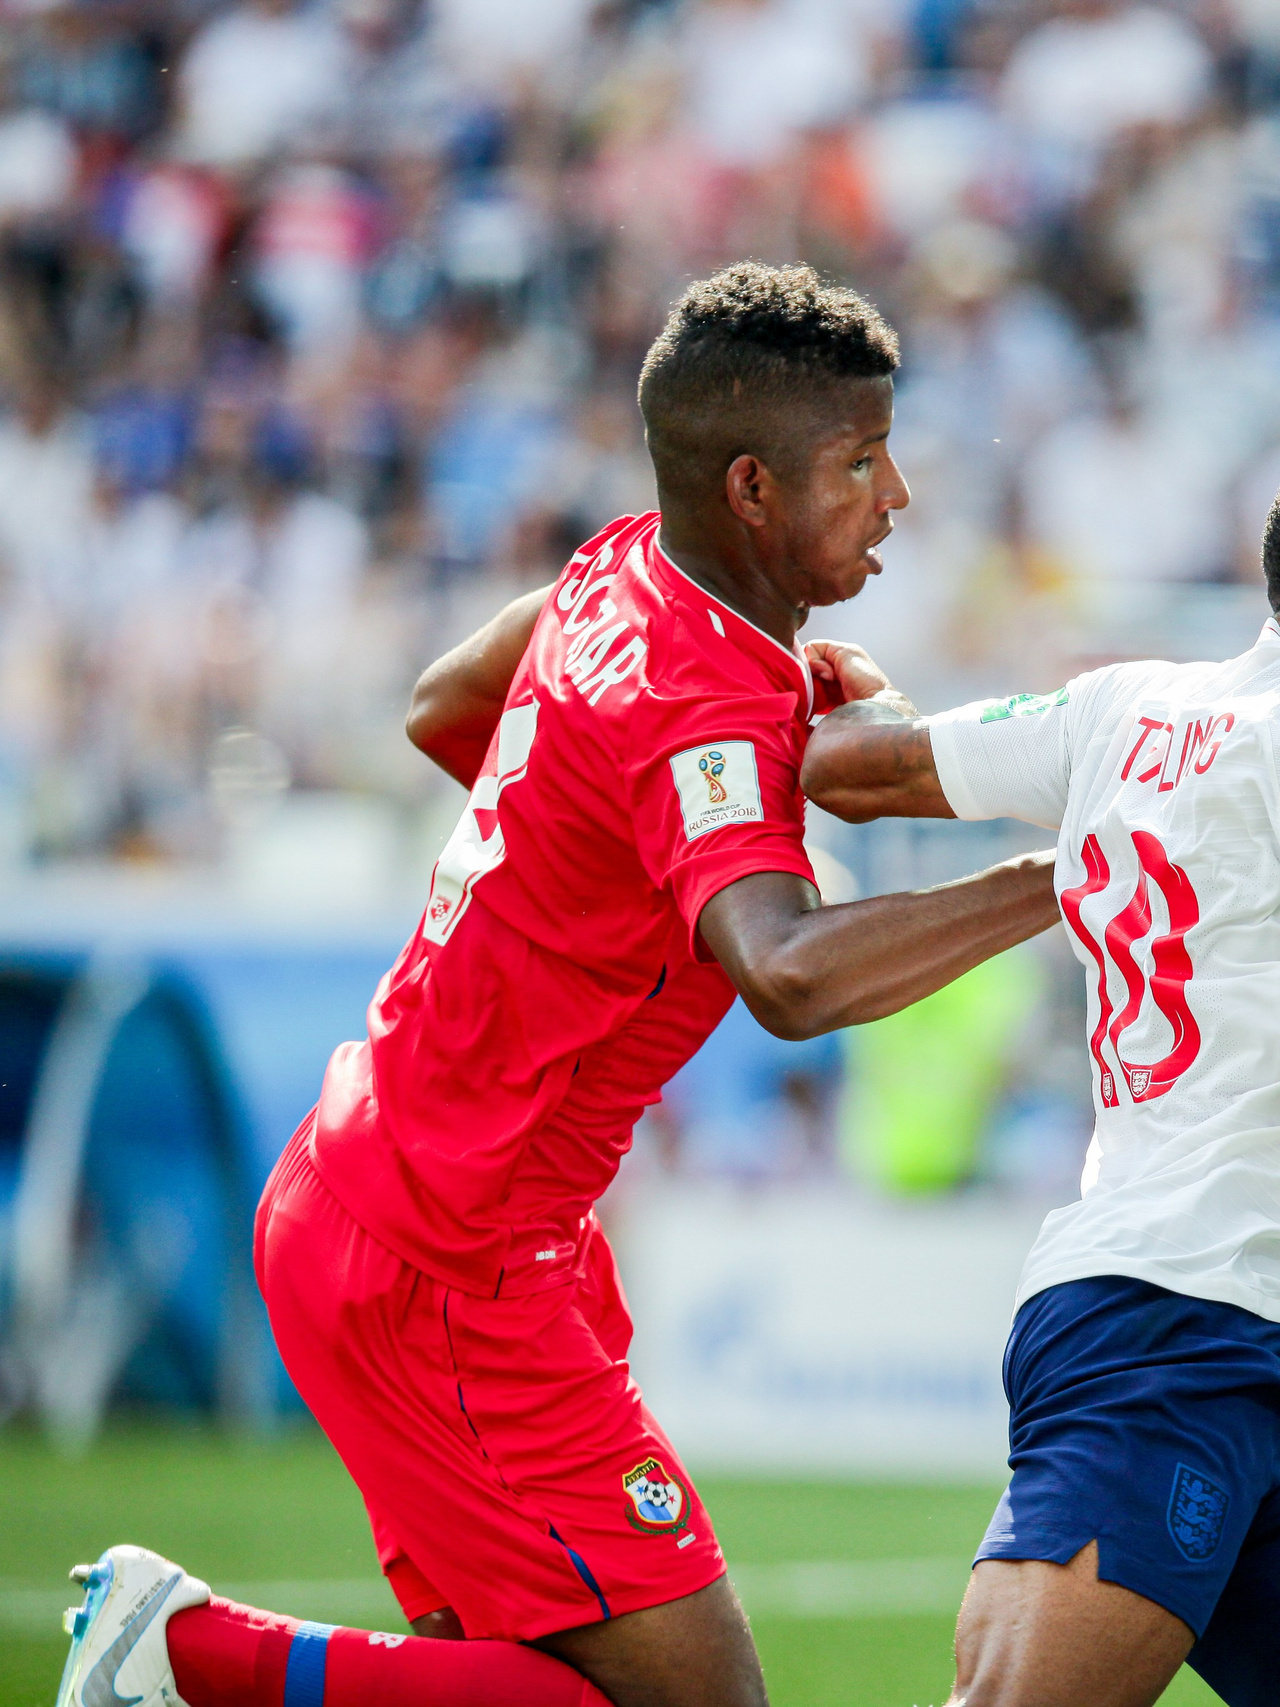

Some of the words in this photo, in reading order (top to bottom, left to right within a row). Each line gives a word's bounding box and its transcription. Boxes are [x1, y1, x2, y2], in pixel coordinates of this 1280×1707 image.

[557, 534, 648, 707] SCAR
[1121, 712, 1235, 793] TLING
[689, 812, 729, 833] RUSSIA
[731, 807, 757, 818] 2018
[711, 805, 730, 814] WORLD
[1060, 830, 1201, 1109] 10
